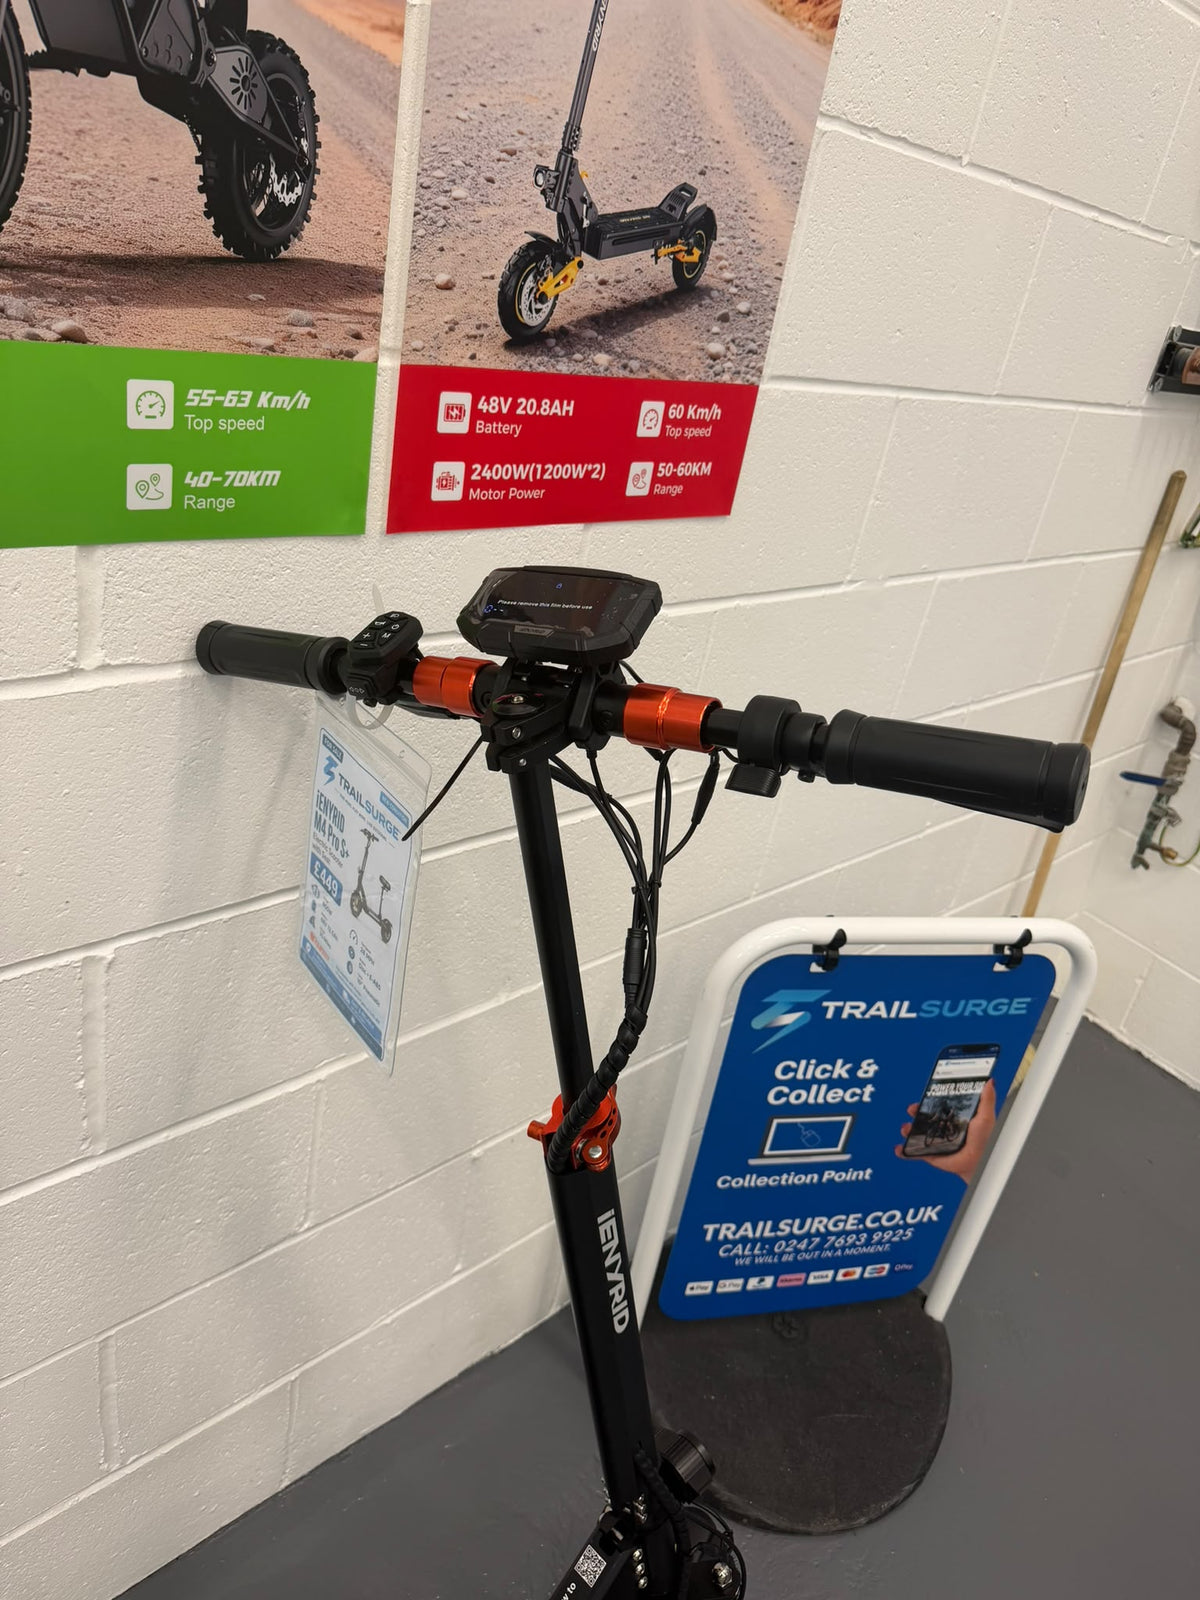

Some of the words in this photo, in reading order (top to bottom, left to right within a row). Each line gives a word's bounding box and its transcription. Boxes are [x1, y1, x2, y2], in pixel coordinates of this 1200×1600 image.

[185, 389, 253, 409] 55-63
[257, 390, 311, 411] Km/h
[477, 396, 513, 414] 48V
[516, 398, 574, 416] 20.8AH
[668, 404, 684, 419] 60
[686, 403, 722, 421] Km/h
[184, 415, 213, 433] Top
[218, 416, 265, 433] speed
[475, 421, 522, 437] Battery
[665, 425, 682, 438] Top
[684, 426, 712, 438] speed
[184, 470, 281, 487] 40-70KM
[657, 462, 712, 477] 50-60KM
[469, 488, 506, 501] Motor
[509, 488, 545, 500] Power
[653, 484, 683, 497] Range
[184, 495, 236, 512] Range
[338, 772, 400, 842] TRAILSURGE
[314, 811, 327, 837] M4
[327, 825, 340, 852] Pro
[313, 860, 339, 898] £449
[821, 998, 1032, 1020] TRAILSURGE
[774, 1058, 853, 1081] Click
[856, 1058, 879, 1079] &
[767, 1083, 875, 1106] Collect
[716, 1171, 818, 1189] Collection
[822, 1168, 873, 1183] Point
[703, 1205, 943, 1242] TRAILSURGE.CO.UK
[718, 1242, 769, 1258] CALL:
[774, 1238, 820, 1253] 0247
[825, 1232, 868, 1248] 7693
[871, 1227, 914, 1243] 9925
[735, 1256, 753, 1266] WE
[754, 1254, 778, 1265] WILL
[781, 1253, 794, 1263] BE
[797, 1250, 820, 1261] OUT
[821, 1249, 833, 1258] IN
[834, 1248, 842, 1257] A
[567, 1582, 576, 1594] to
